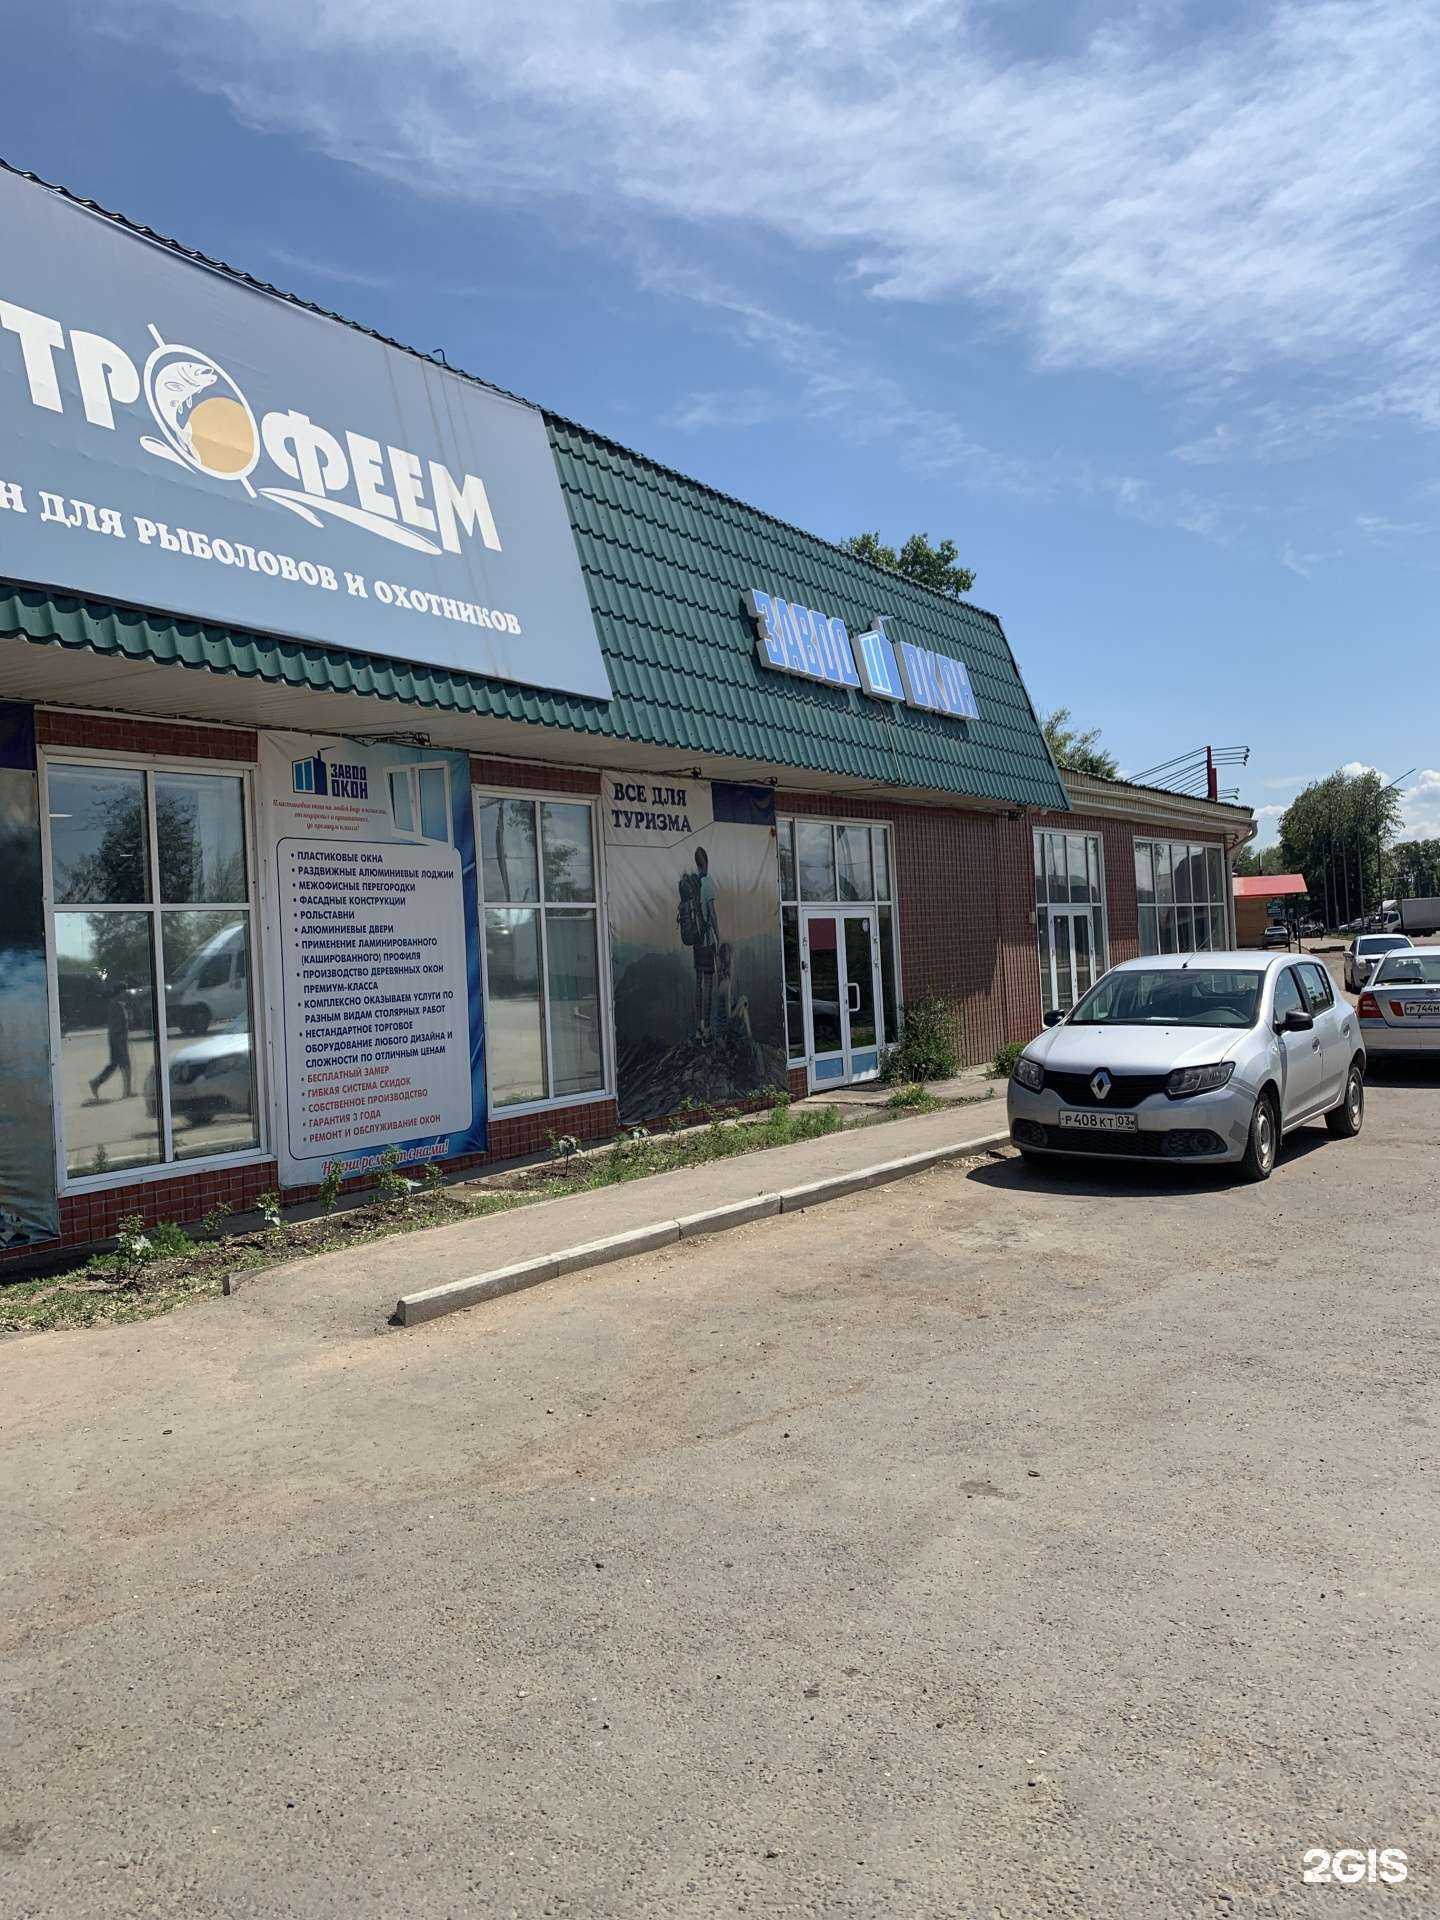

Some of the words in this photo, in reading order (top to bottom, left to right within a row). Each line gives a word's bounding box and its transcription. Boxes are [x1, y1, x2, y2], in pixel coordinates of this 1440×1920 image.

[0, 300, 502, 554] ТРОФЕЕМ
[38, 491, 126, 538] ДЛЯ
[133, 516, 338, 590] РЫБОЛОВОВ
[344, 571, 368, 598] И
[374, 580, 521, 634] ОХОТНИКОВ
[899, 640, 981, 720] ОКОН
[332, 779, 368, 799] ОКОН
[612, 782, 647, 803] ВСЕ
[652, 787, 687, 807] ДЛЯ
[612, 809, 692, 832] ТУРИЗМА
[297, 851, 358, 862] ПЛАСТИКОВЫЕ
[360, 854, 383, 863] ОКНА
[298, 866, 356, 876] РАЗДВИЖНЫЕ
[359, 868, 419, 878] АЛЮМИНИЕВЫЕ
[421, 870, 454, 880] ЛОДЖИИ
[299, 881, 360, 891] МЕЖОФИСНЫЕ
[362, 882, 416, 892] ПЕРЕГОРОДКИ
[299, 896, 347, 906] ФАСАДНЫЕ
[349, 896, 406, 906] КОНСТРУКЦИИ
[300, 911, 355, 919] РОЛЬСТАВНИ
[301, 925, 367, 934] АЛЮМИНИЕВЫЕ
[369, 925, 394, 935] ДВЕРИ
[301, 940, 356, 949] ПРИМЕНЕНИЕ
[358, 938, 438, 948] ЛАМИНИРОВАННОГО
[301, 953, 381, 966] (КАШИРОВАННОГО)
[383, 952, 421, 961] ПРОФИЛЯ
[303, 968, 369, 978] ПРОИЗВОДСТВО
[371, 966, 421, 977] ДЕРЕВЯННЫХ
[423, 964, 444, 973] ОКОН
[303, 982, 379, 994] ПРЕМИУМ-КЛАССА
[304, 997, 361, 1009] КОМПЛЕКСНО
[363, 993, 412, 1005] ОКАЗЫВАЕМ
[413, 991, 441, 1001] УСЛУГИ
[443, 991, 454, 999] ПО
[305, 1012, 341, 1024] РАЗНЫМ
[343, 1010, 373, 1021] ВИДАМ
[374, 1007, 420, 1018] СТОЛЯРНЫХ
[422, 1005, 446, 1014] РАБОТ
[305, 1024, 373, 1038] НЕСТАНДАРТНОЕ
[374, 1021, 413, 1032] ТОРГОВОЕ
[305, 1038, 373, 1053] ОБОРУДОВАНИЕ
[374, 1035, 409, 1047] ЛЮБОГО
[410, 1031, 446, 1044] ДИЗАЙНА
[447, 1031, 453, 1039] И
[305, 1054, 358, 1068] СЛОЖНОСТИ
[360, 1053, 373, 1062] ПО
[375, 1048, 419, 1061] ОТЛИЧНЫМ
[420, 1045, 446, 1056] ЦЕНАМ
[307, 1067, 362, 1083] БЕСПЛАТНЫЙ
[365, 1065, 390, 1076] ЗАМЕР
[308, 1086, 339, 1098] ГИБКАЯ
[342, 1081, 378, 1093] СИСТЕМА
[380, 1076, 411, 1089] СКИДОК
[308, 1098, 366, 1113] СОБСТВЕННОЕ
[367, 1088, 428, 1104] ПРОИЗВОДСТВО
[309, 1115, 350, 1128] ГАРАНТИЯ
[353, 1112, 358, 1120] 3
[360, 1109, 381, 1120] ГОДА
[309, 1129, 342, 1143] РЕМОНТ
[344, 1128, 351, 1137] И
[353, 1119, 418, 1135] ОБСЛУЖИВАНИЕ
